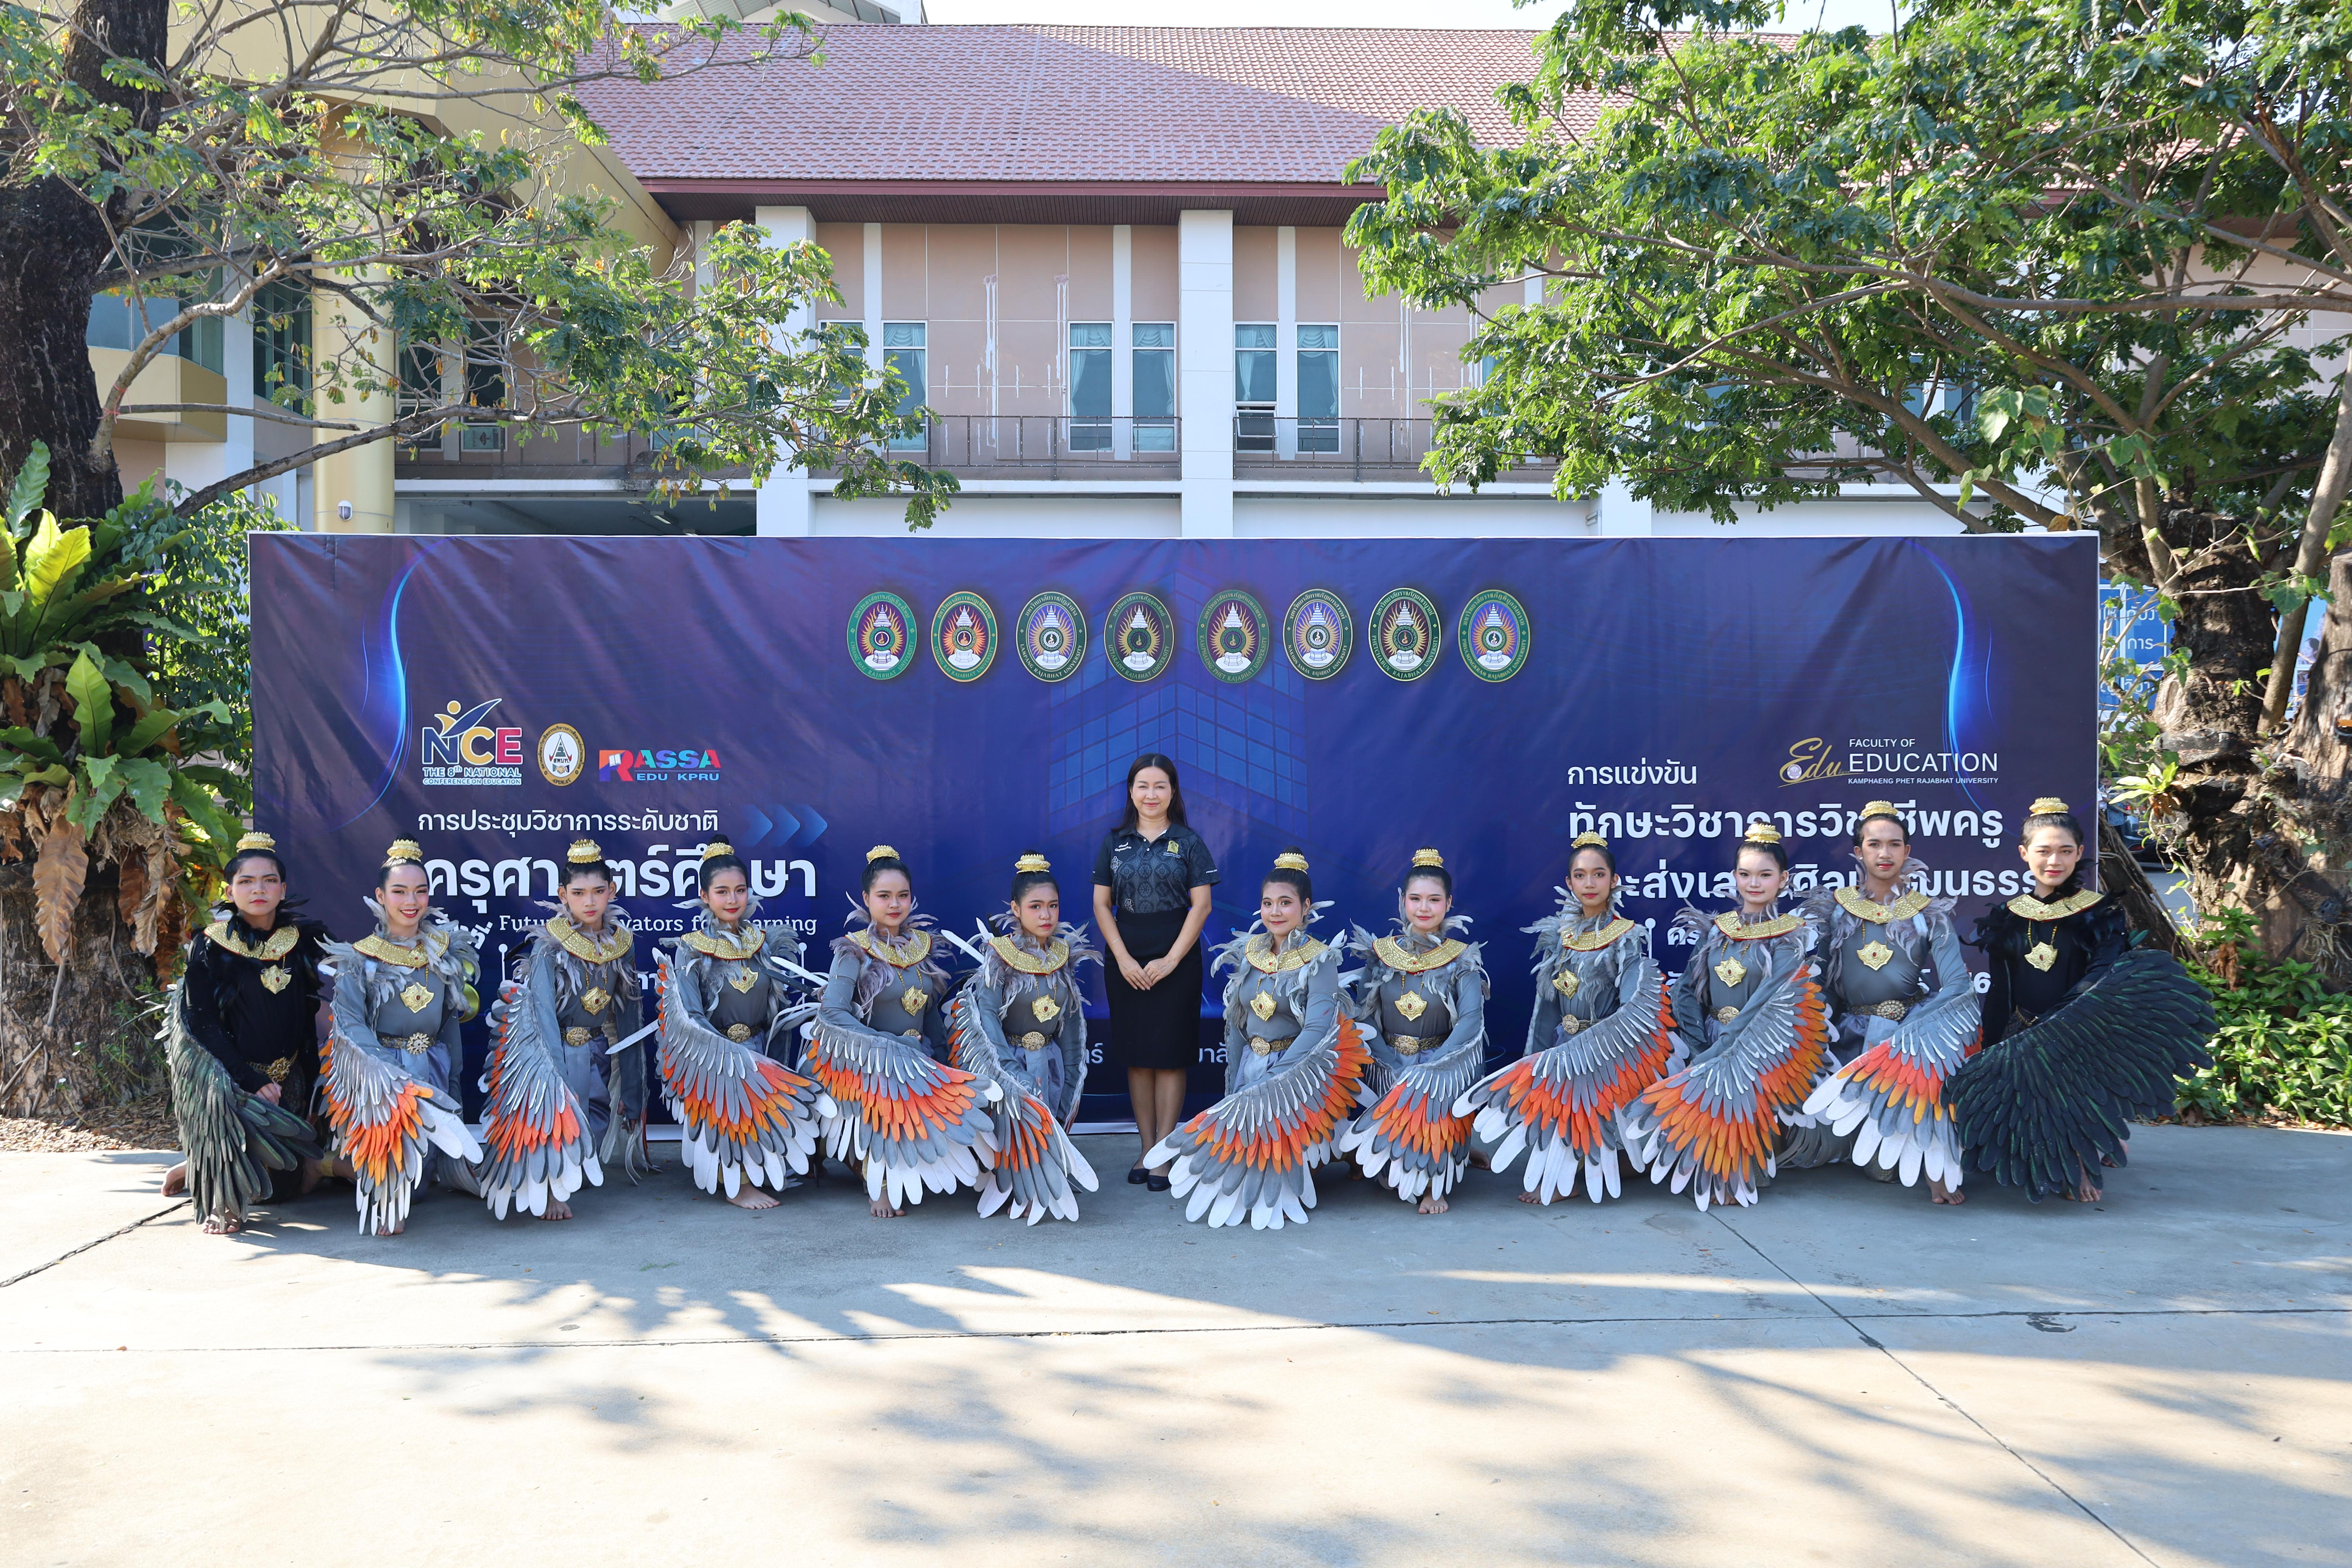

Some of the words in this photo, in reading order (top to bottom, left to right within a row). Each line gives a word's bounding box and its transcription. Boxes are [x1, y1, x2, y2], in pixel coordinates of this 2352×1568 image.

[850, 642, 859, 660] CHIANG
[857, 662, 866, 671] MAI
[868, 670, 897, 678] RAJABHAT
[898, 641, 914, 670] UNIVERSITY
[934, 646, 945, 664] CHIANG
[943, 664, 951, 672] RAI
[977, 646, 994, 672] UNIVERSITY
[1020, 644, 1034, 669] LAMPANG
[1034, 668, 1062, 678] RAJABHAT
[1064, 645, 1083, 674] UNIVERSITY
[1108, 645, 1125, 672] UTTARADIT
[1125, 670, 1152, 679] RAJABHAT
[1152, 645, 1170, 674] UNIVERSITY
[1199, 635, 1214, 669] KAMPHAENG
[1213, 668, 1226, 679] PHET
[1227, 668, 1254, 682] RAJABHAT
[1254, 636, 1267, 668] UNIVERSITY
[1288, 645, 1299, 664] NAKHON
[1297, 663, 1310, 674] SAWAN
[1312, 668, 1331, 677] RAJABHAT
[1332, 645, 1348, 670] UNIVERSITY
[1372, 635, 1391, 671] PHETCHABUN
[1392, 668, 1423, 678] RAJABHAT
[1424, 636, 1438, 667] UNIVERSITY
[1462, 639, 1487, 677] PIBULSONGKRAM
[1488, 668, 1513, 680] RAJABHAT
[1512, 639, 1527, 669] UNIVERSITY
[422, 726, 523, 765] NCE
[1849, 739, 1897, 747] FACULTY
[1900, 739, 1916, 747] OF
[422, 767, 445, 777] THE
[447, 765, 462, 777] 8th
[464, 767, 522, 777] NATIONAL
[599, 750, 721, 781] RASSA
[1568, 757, 1697, 784] การแข่งขัน
[1779, 737, 1841, 783] Edu
[1850, 753, 1997, 772] EDUCATION
[418, 808, 718, 838] การประชุมวิชาการระดับชาติ
[424, 843, 816, 914] ครุศาตร์ศึษา
[499, 916, 550, 931] Futu
[691, 915, 708, 931] fo
[743, 916, 817, 935] arning
